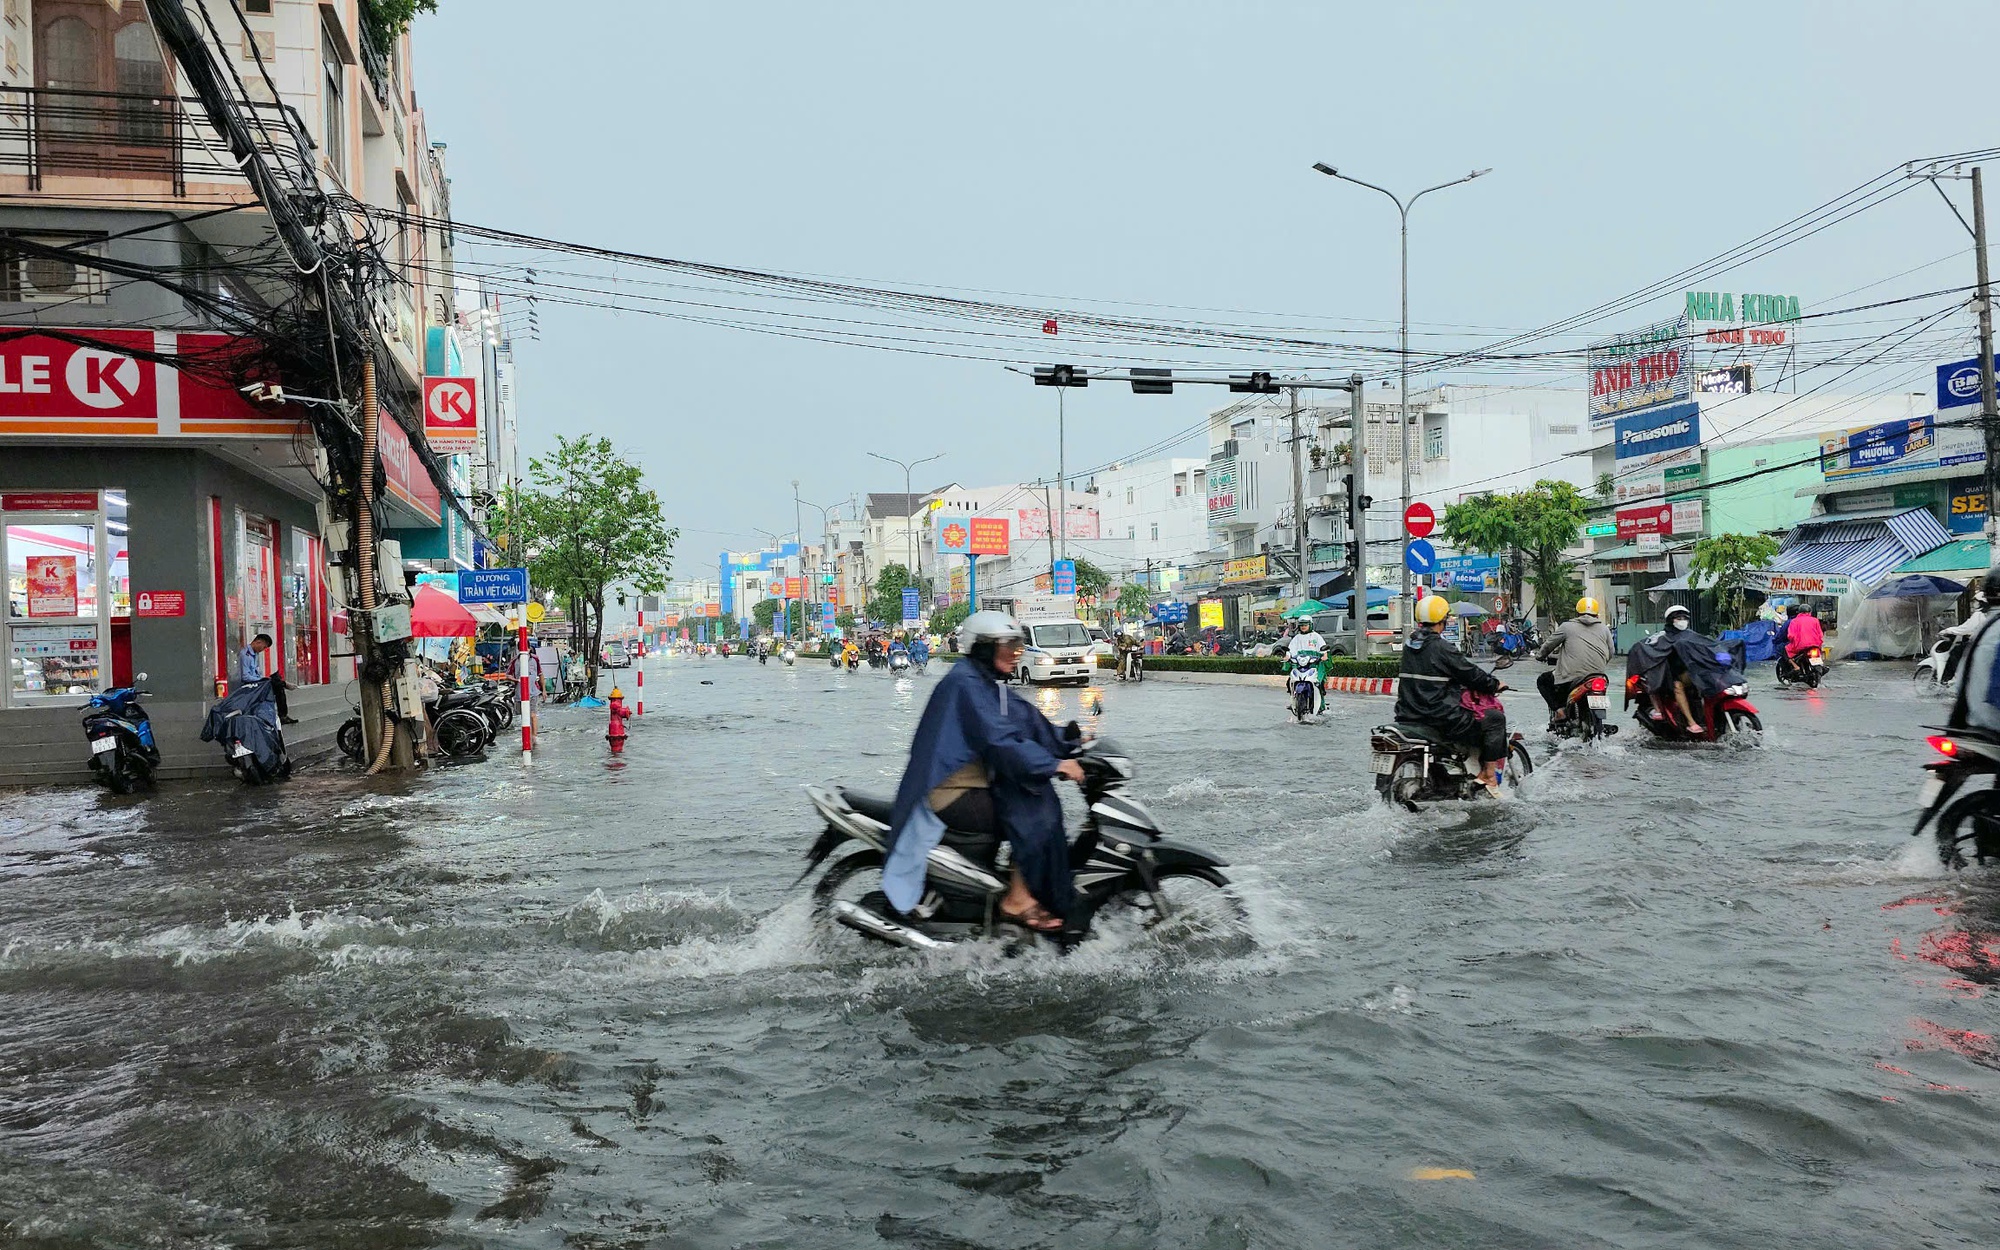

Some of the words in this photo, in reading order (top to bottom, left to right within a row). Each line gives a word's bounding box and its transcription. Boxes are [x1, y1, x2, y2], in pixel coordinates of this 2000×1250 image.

[1686, 291, 1735, 321] NHA
[1742, 294, 1802, 324] KHOA
[1705, 328, 1744, 344] ANH
[1593, 363, 1633, 396] ANH
[1622, 420, 1690, 445] Panasonic
[1904, 437, 1930, 453] LARUE
